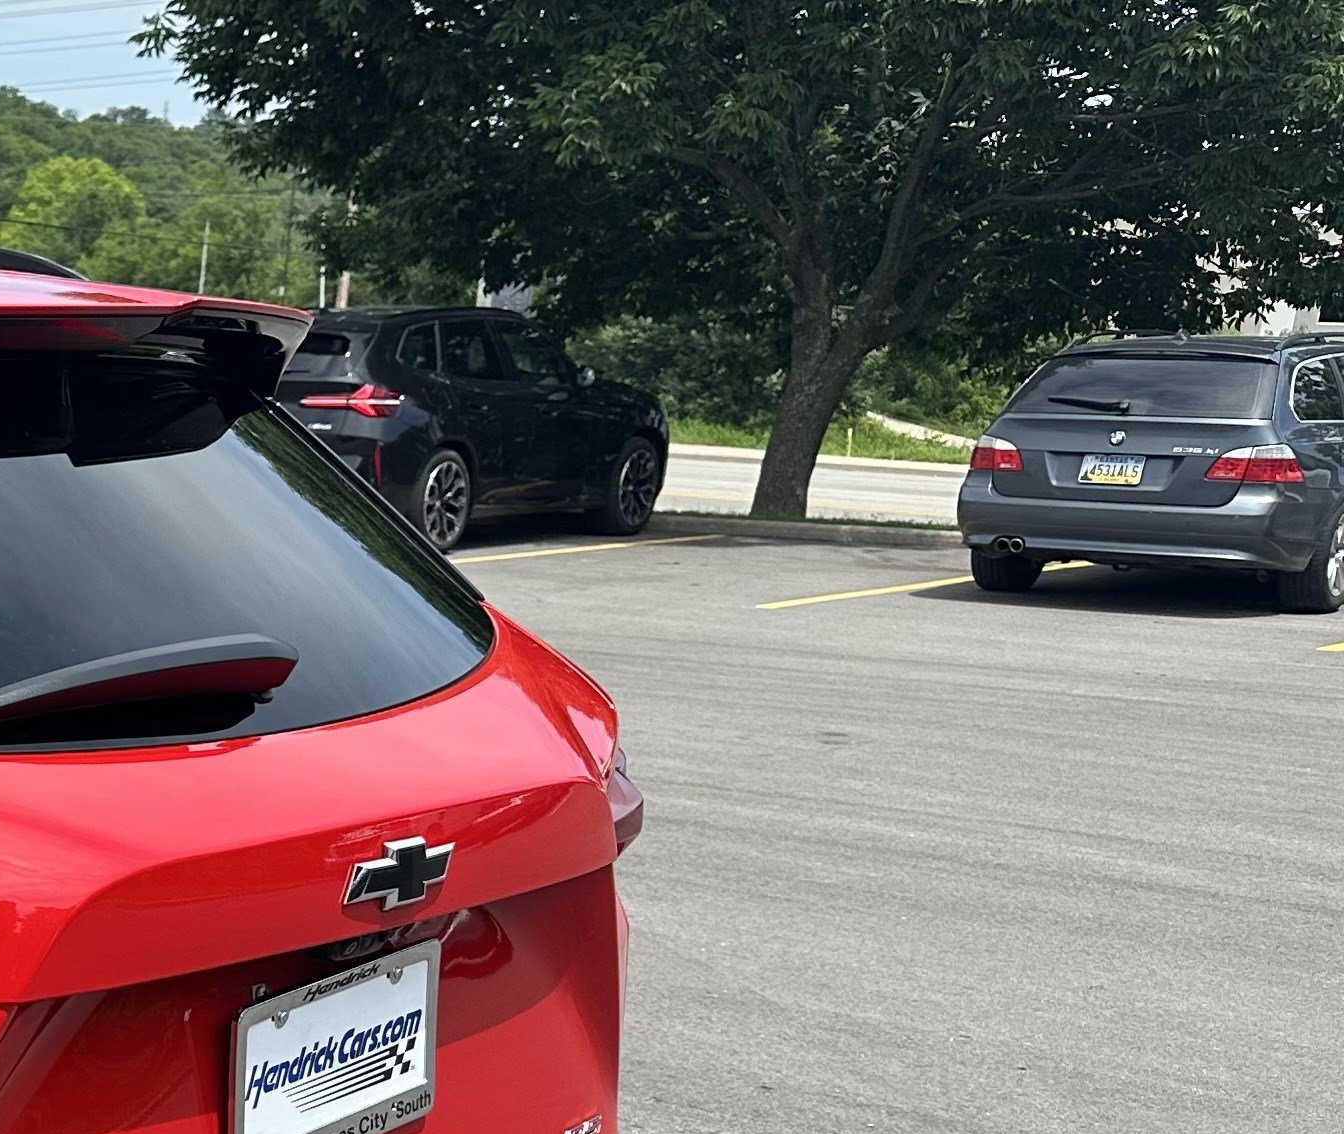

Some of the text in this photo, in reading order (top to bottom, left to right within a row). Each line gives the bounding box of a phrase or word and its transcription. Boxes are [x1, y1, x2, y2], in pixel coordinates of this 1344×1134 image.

[302, 963, 381, 1002] Hendrick
[359, 1111, 389, 1134] City
[395, 1089, 431, 1119] South
